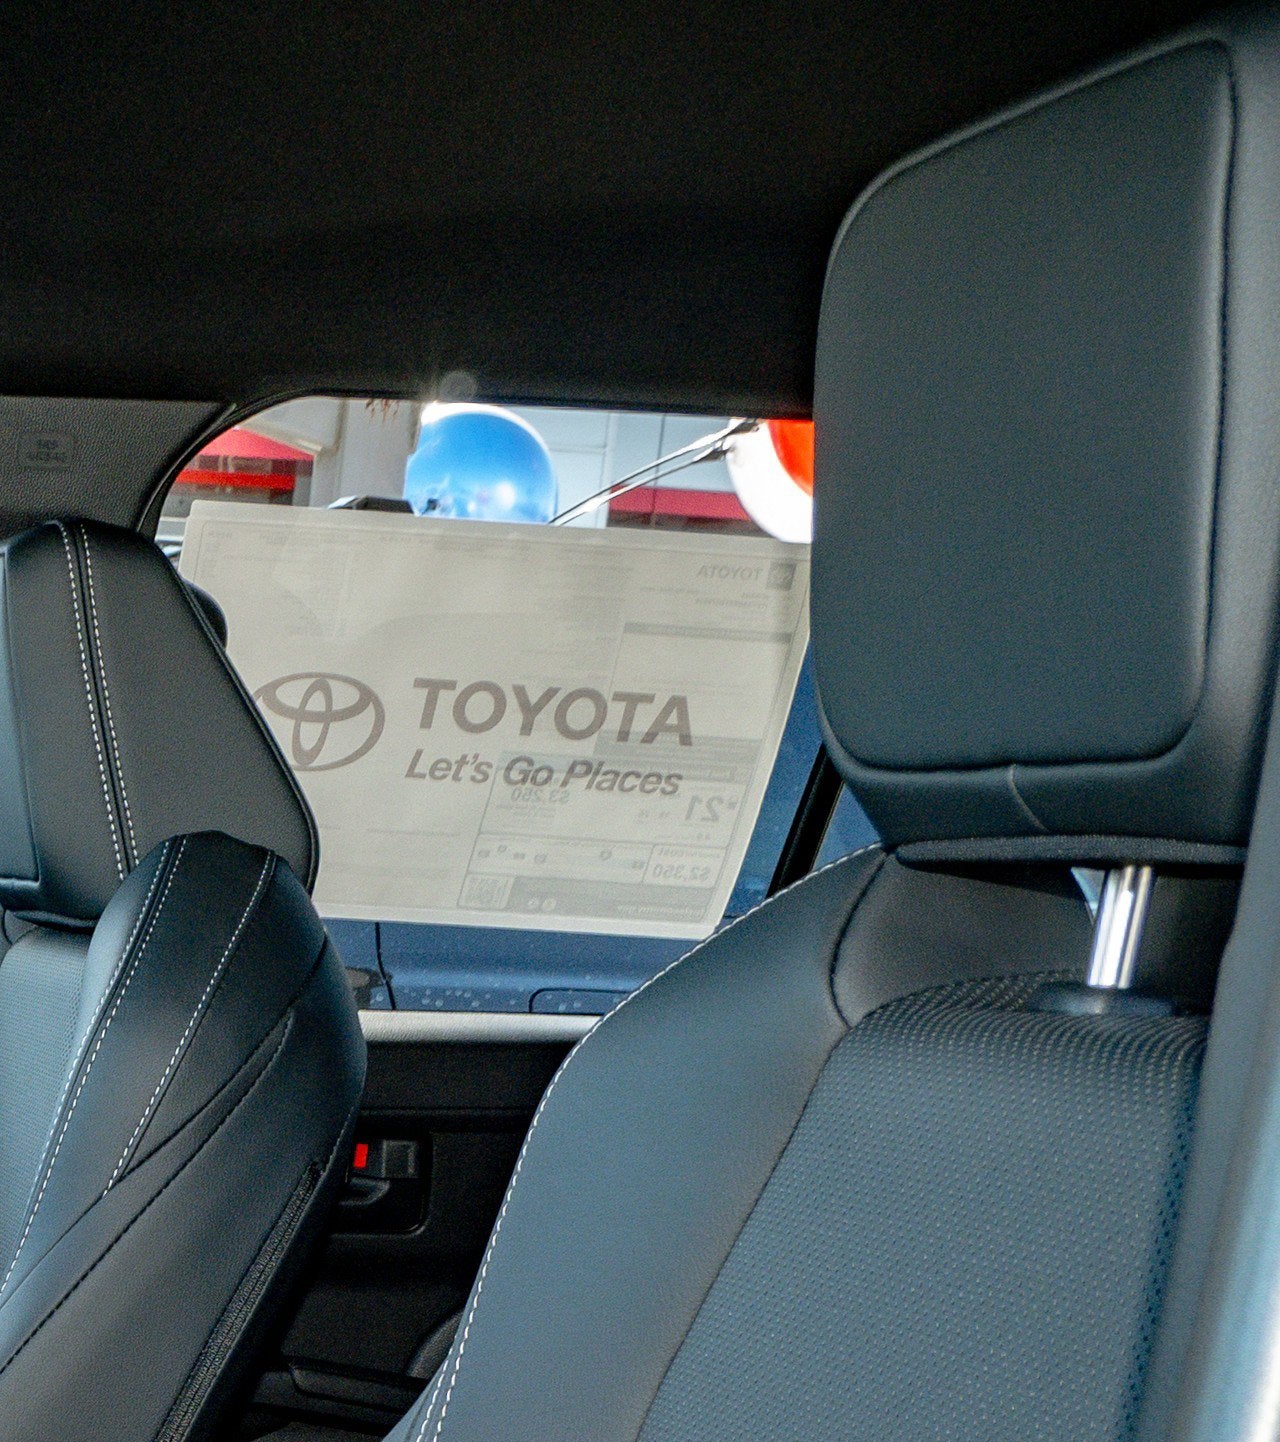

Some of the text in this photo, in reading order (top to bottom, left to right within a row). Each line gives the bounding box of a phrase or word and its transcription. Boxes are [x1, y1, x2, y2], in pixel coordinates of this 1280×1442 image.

[413, 677, 693, 746] TOYOTA
[404, 749, 683, 795] Let's Go Places
